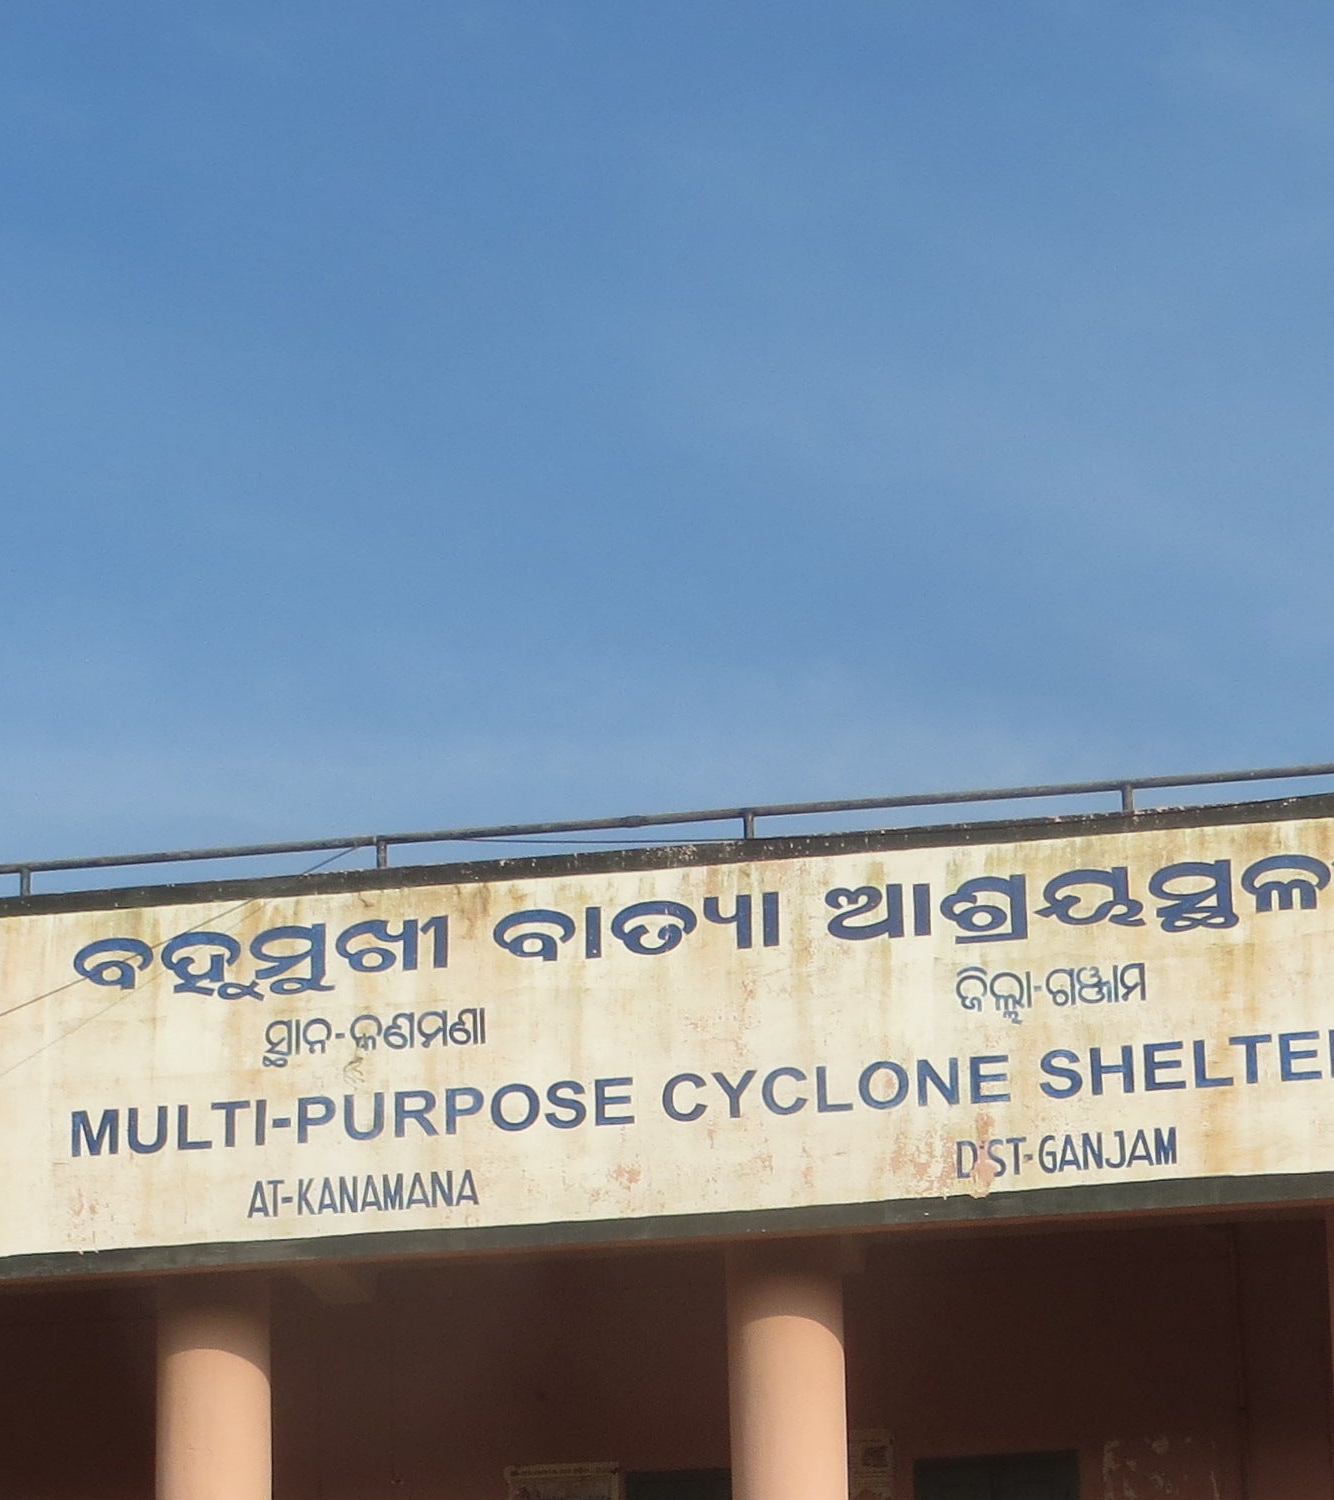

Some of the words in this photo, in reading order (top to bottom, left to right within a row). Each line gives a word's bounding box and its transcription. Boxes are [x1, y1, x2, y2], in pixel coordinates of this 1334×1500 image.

[73, 914, 449, 1002] ବହୁମୁଖୀ
[491, 890, 780, 962] ବାତ୍ୟା
[71, 1075, 635, 1158] MULTI-PURPOSE
[661, 1054, 1010, 1123] CYCLONE
[956, 1127, 1177, 1178] DST-GANJAM
[247, 1170, 480, 1220] AT-KANAMANA
